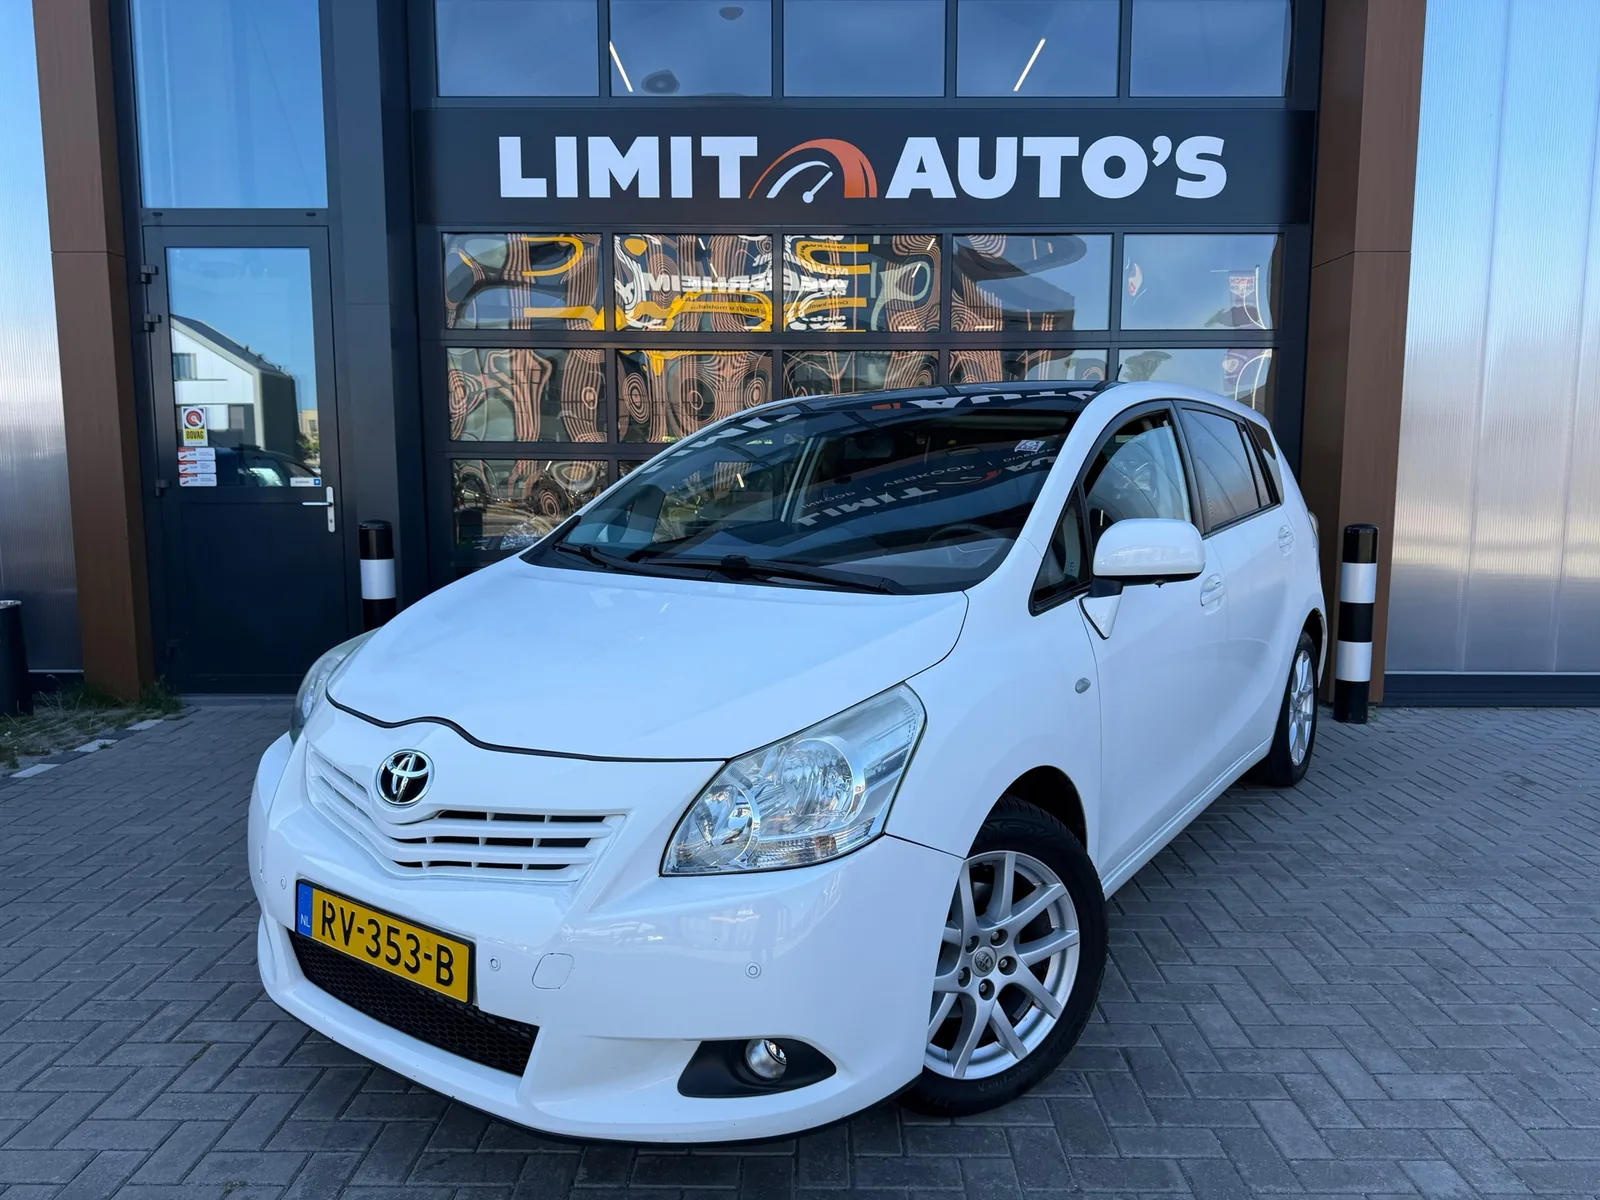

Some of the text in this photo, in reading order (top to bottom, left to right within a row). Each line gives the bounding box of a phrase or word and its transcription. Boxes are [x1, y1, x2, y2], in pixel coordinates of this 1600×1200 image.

[499, 135, 1227, 199] LIMIT AUTO'S
[186, 430, 204, 440] BOVAG
[300, 913, 311, 929] NL
[322, 899, 454, 987] RV-353-B
